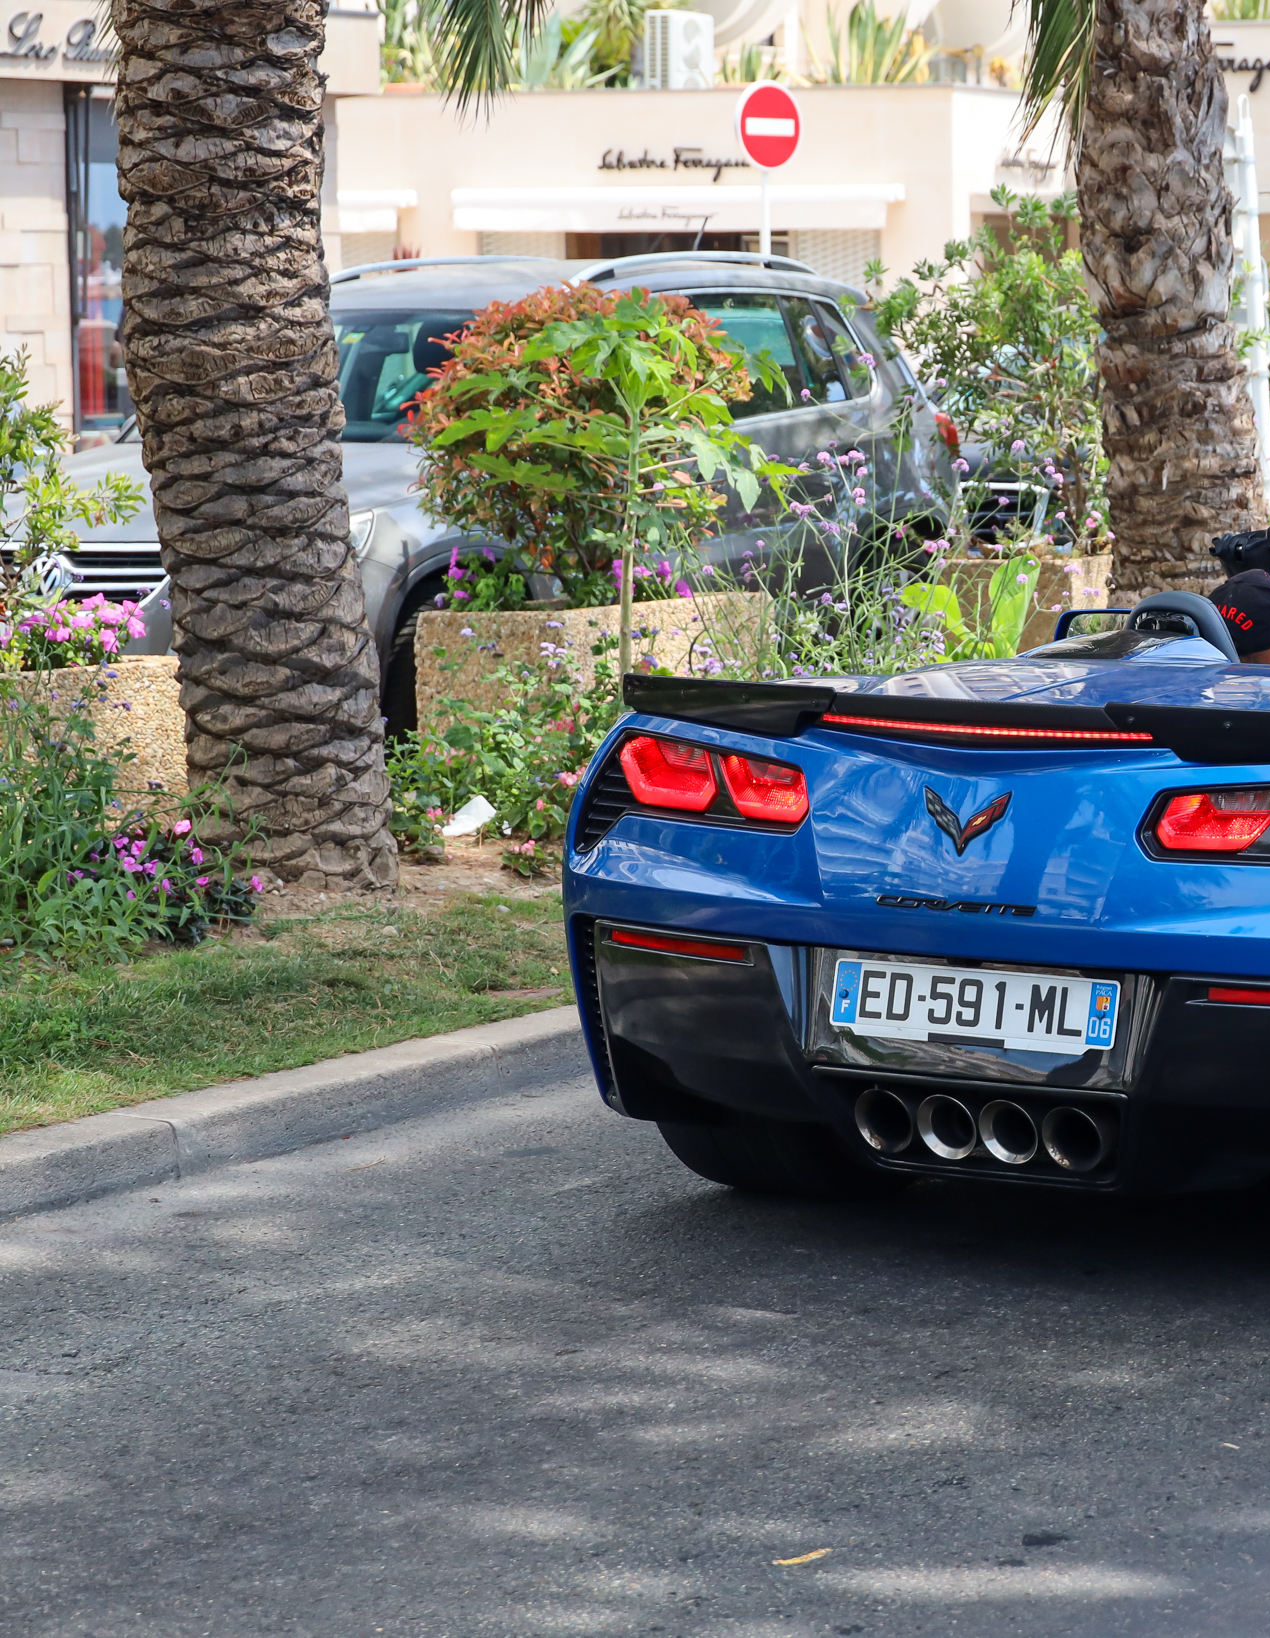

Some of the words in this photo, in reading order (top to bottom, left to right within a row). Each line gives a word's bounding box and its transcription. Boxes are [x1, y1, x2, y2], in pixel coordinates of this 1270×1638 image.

[598, 148, 669, 171] Salvatore
[1216, 604, 1254, 631] ARED
[876, 895, 1037, 917] CORVETTE
[840, 999, 852, 1014] F
[858, 969, 1083, 1038] ED-591-ML
[1088, 1016, 1111, 1038] 06
